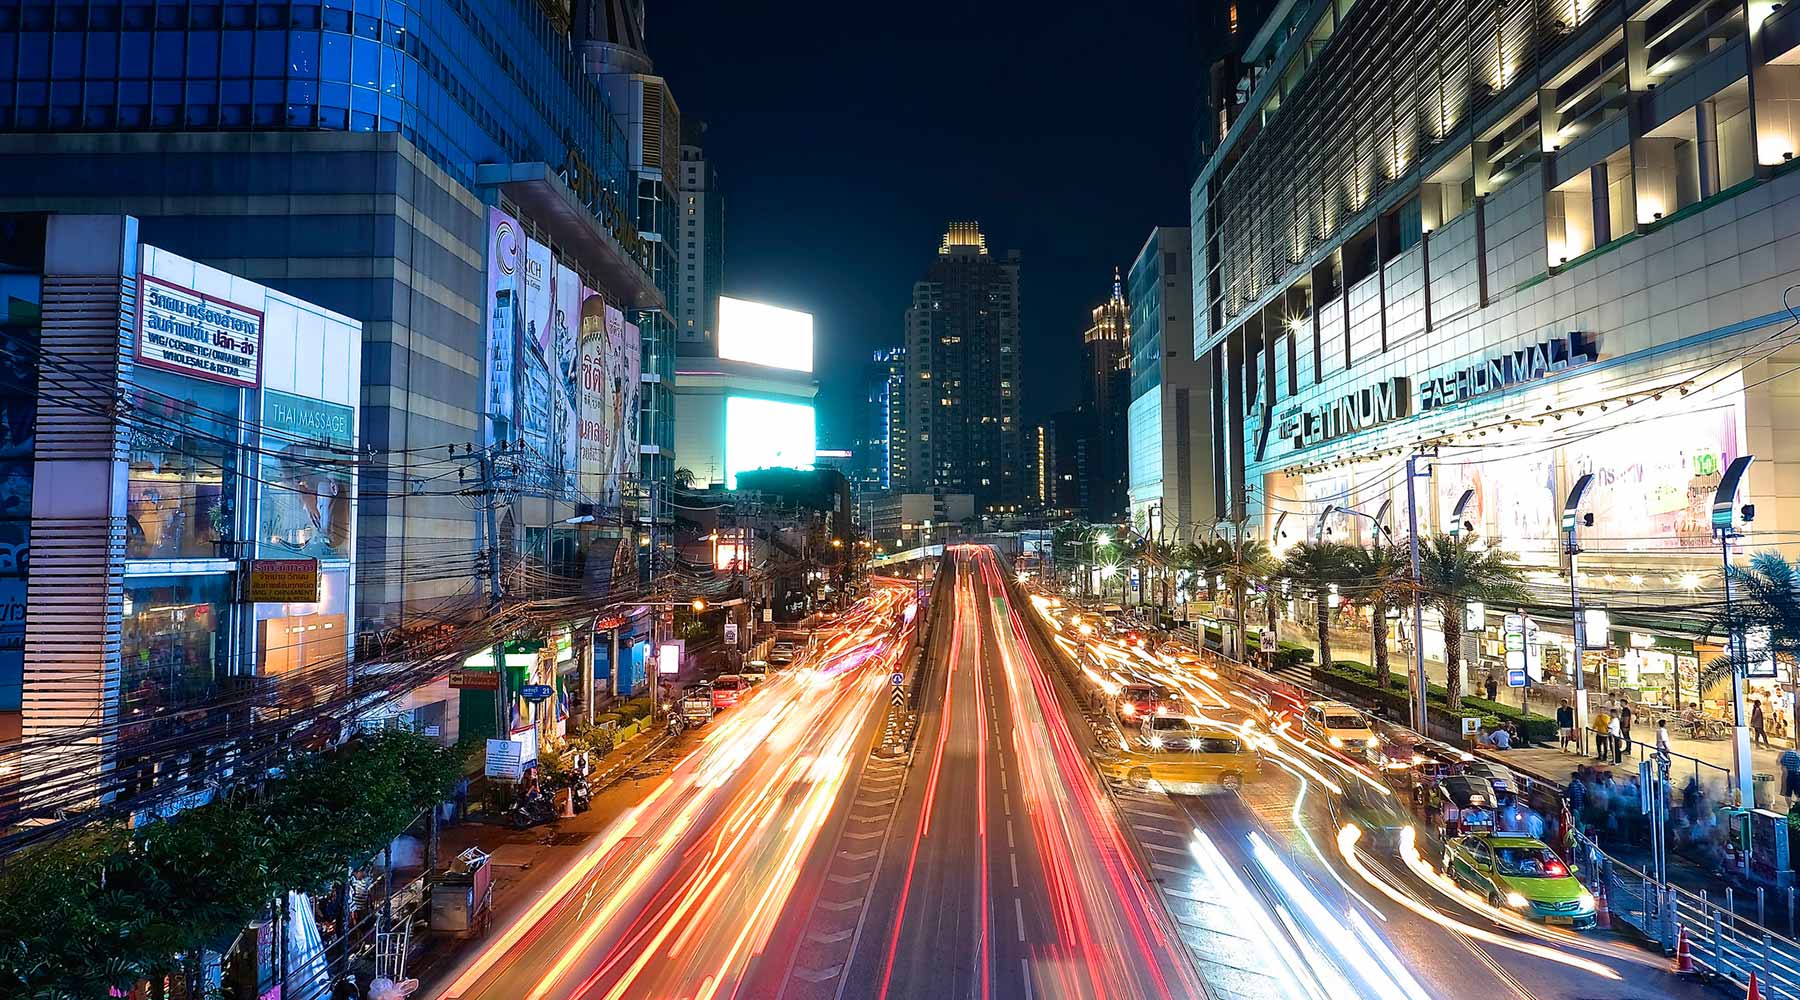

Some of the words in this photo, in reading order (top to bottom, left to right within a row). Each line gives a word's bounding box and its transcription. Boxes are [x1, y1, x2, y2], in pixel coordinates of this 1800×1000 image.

[1419, 357, 1507, 411] FASHION
[1511, 331, 1593, 384] MALL
[272, 403, 296, 425] THAI
[299, 408, 345, 434] MASSAGE
